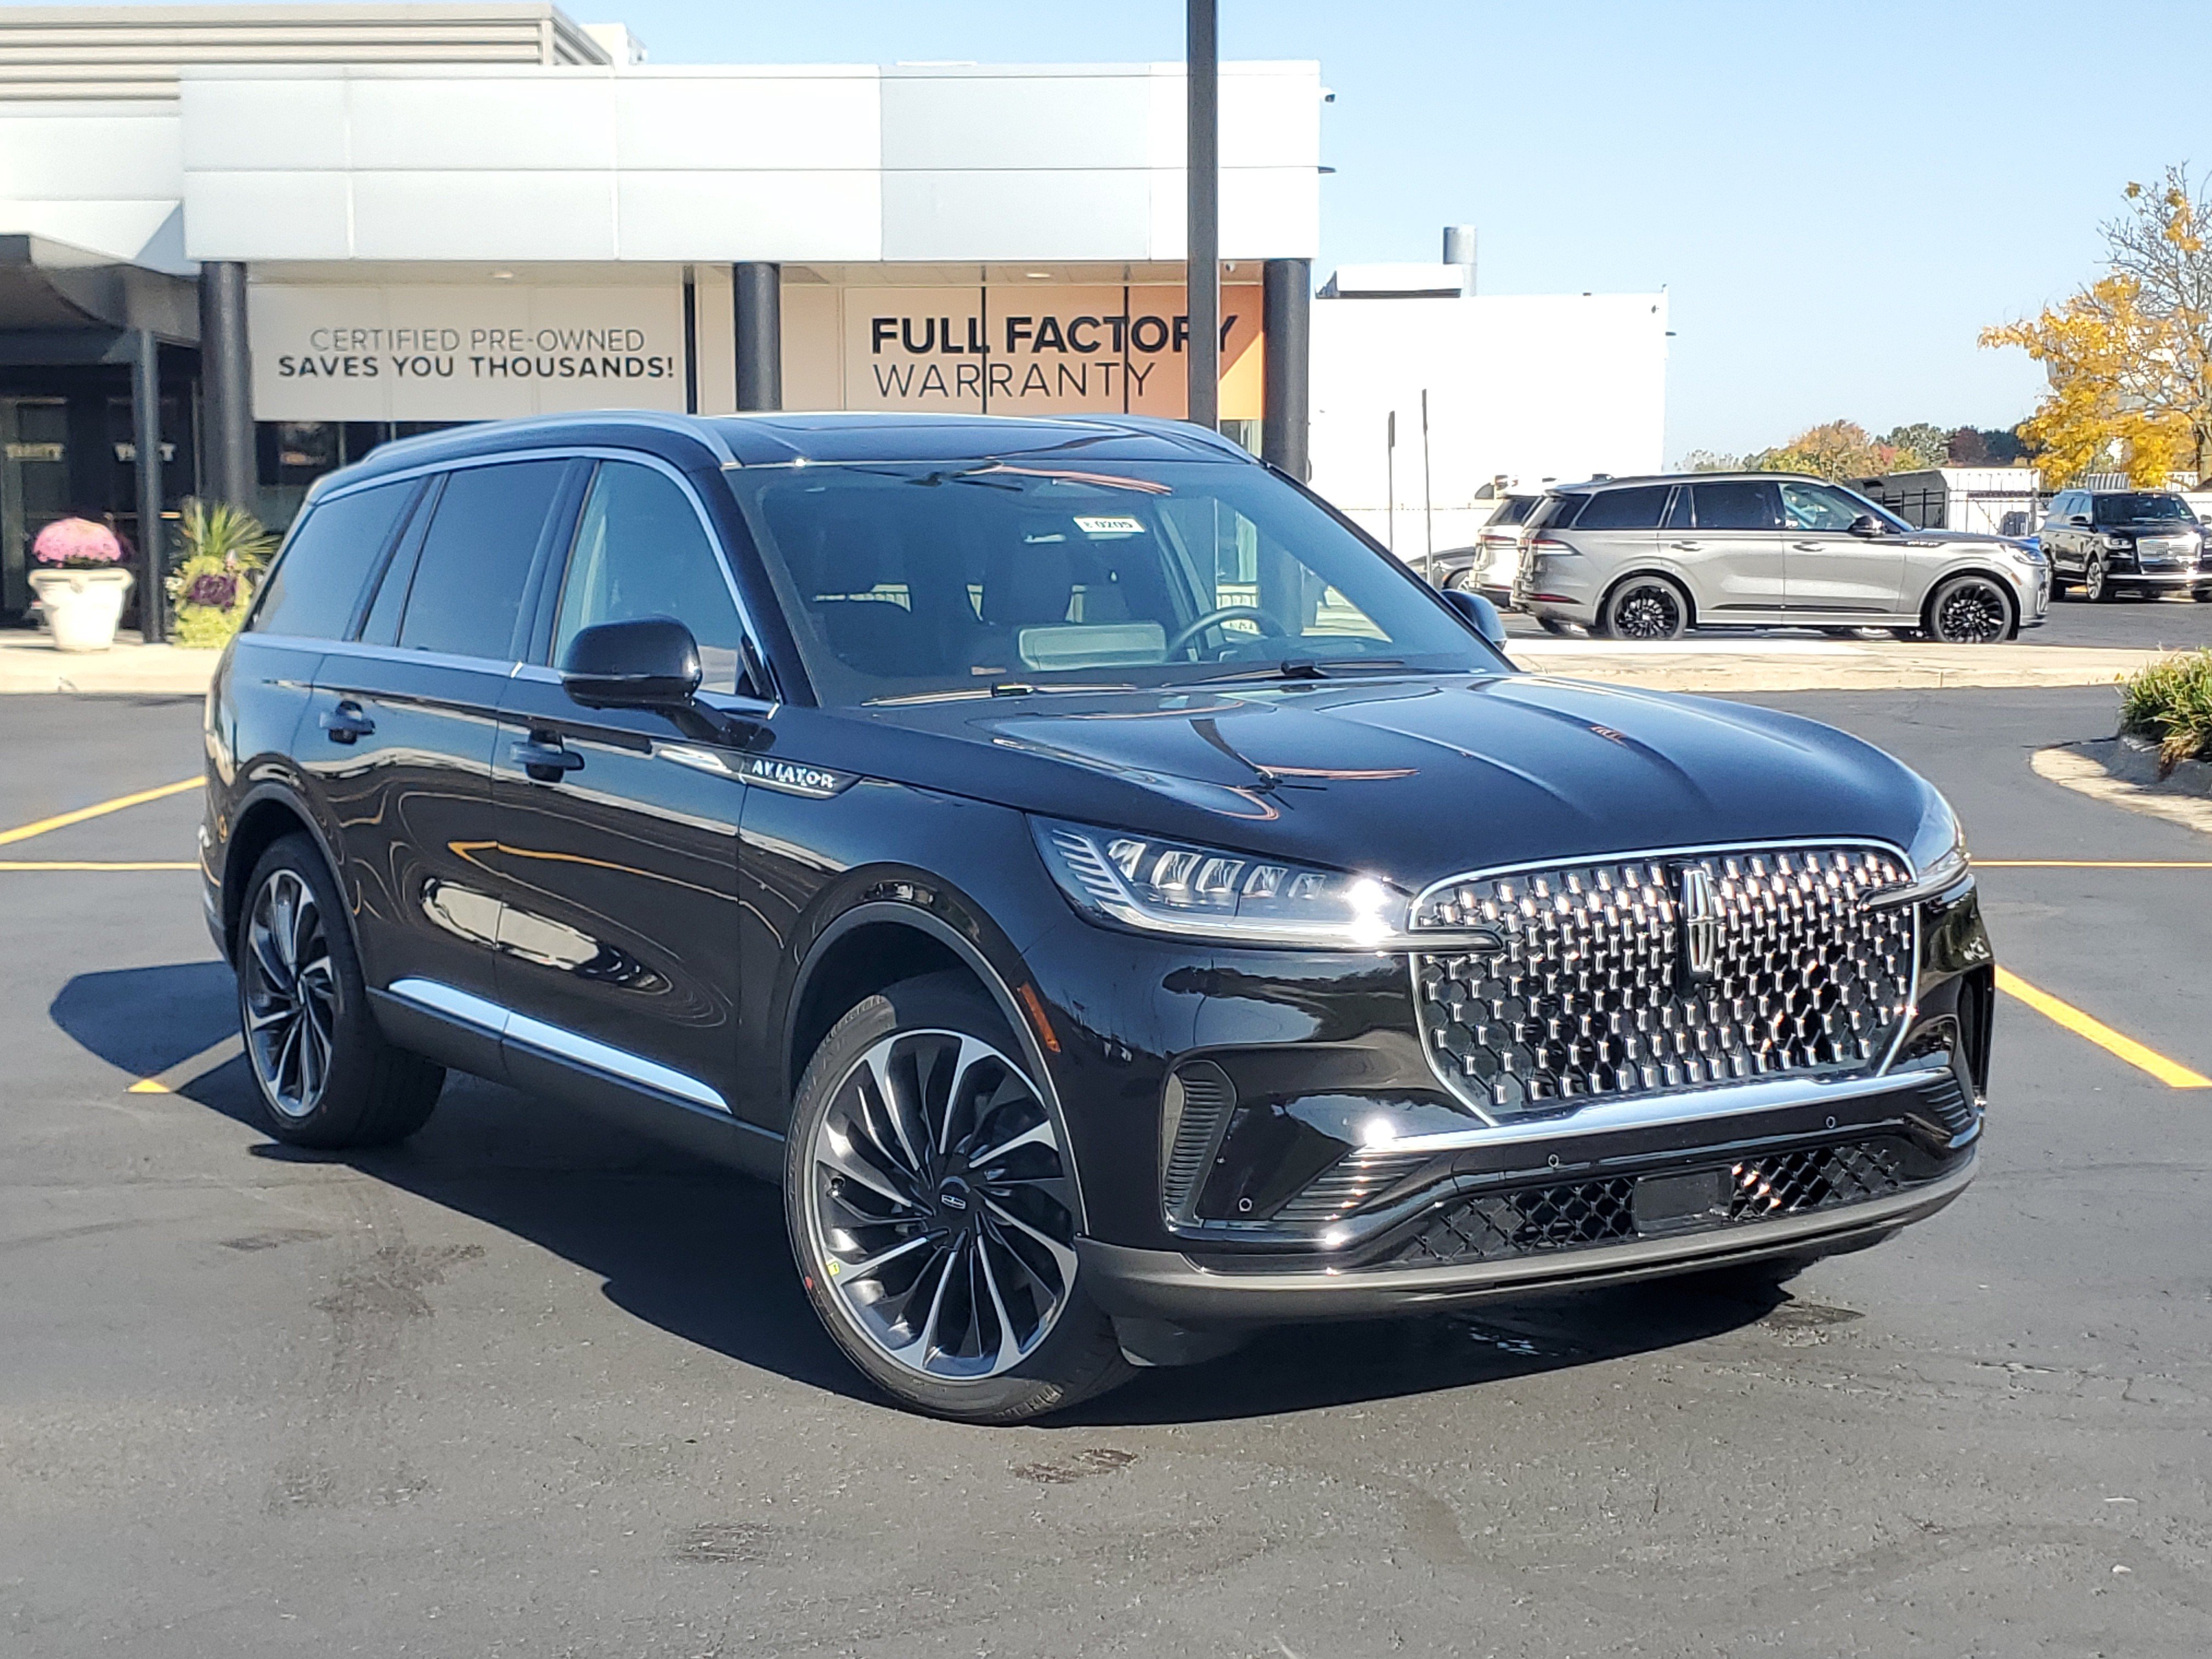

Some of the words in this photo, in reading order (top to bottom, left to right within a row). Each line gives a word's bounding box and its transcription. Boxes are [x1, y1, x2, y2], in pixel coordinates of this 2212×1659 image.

[310, 329, 460, 351] CERTIFIED
[471, 329, 644, 351] PRE-OWNED
[872, 317, 990, 353] FULL
[279, 357, 378, 376] SAVES
[392, 357, 453, 376] YOU
[469, 357, 673, 377] THOUSANDS!
[873, 363, 1155, 397] WARRANTY
[752, 759, 835, 788] AVIATOR
